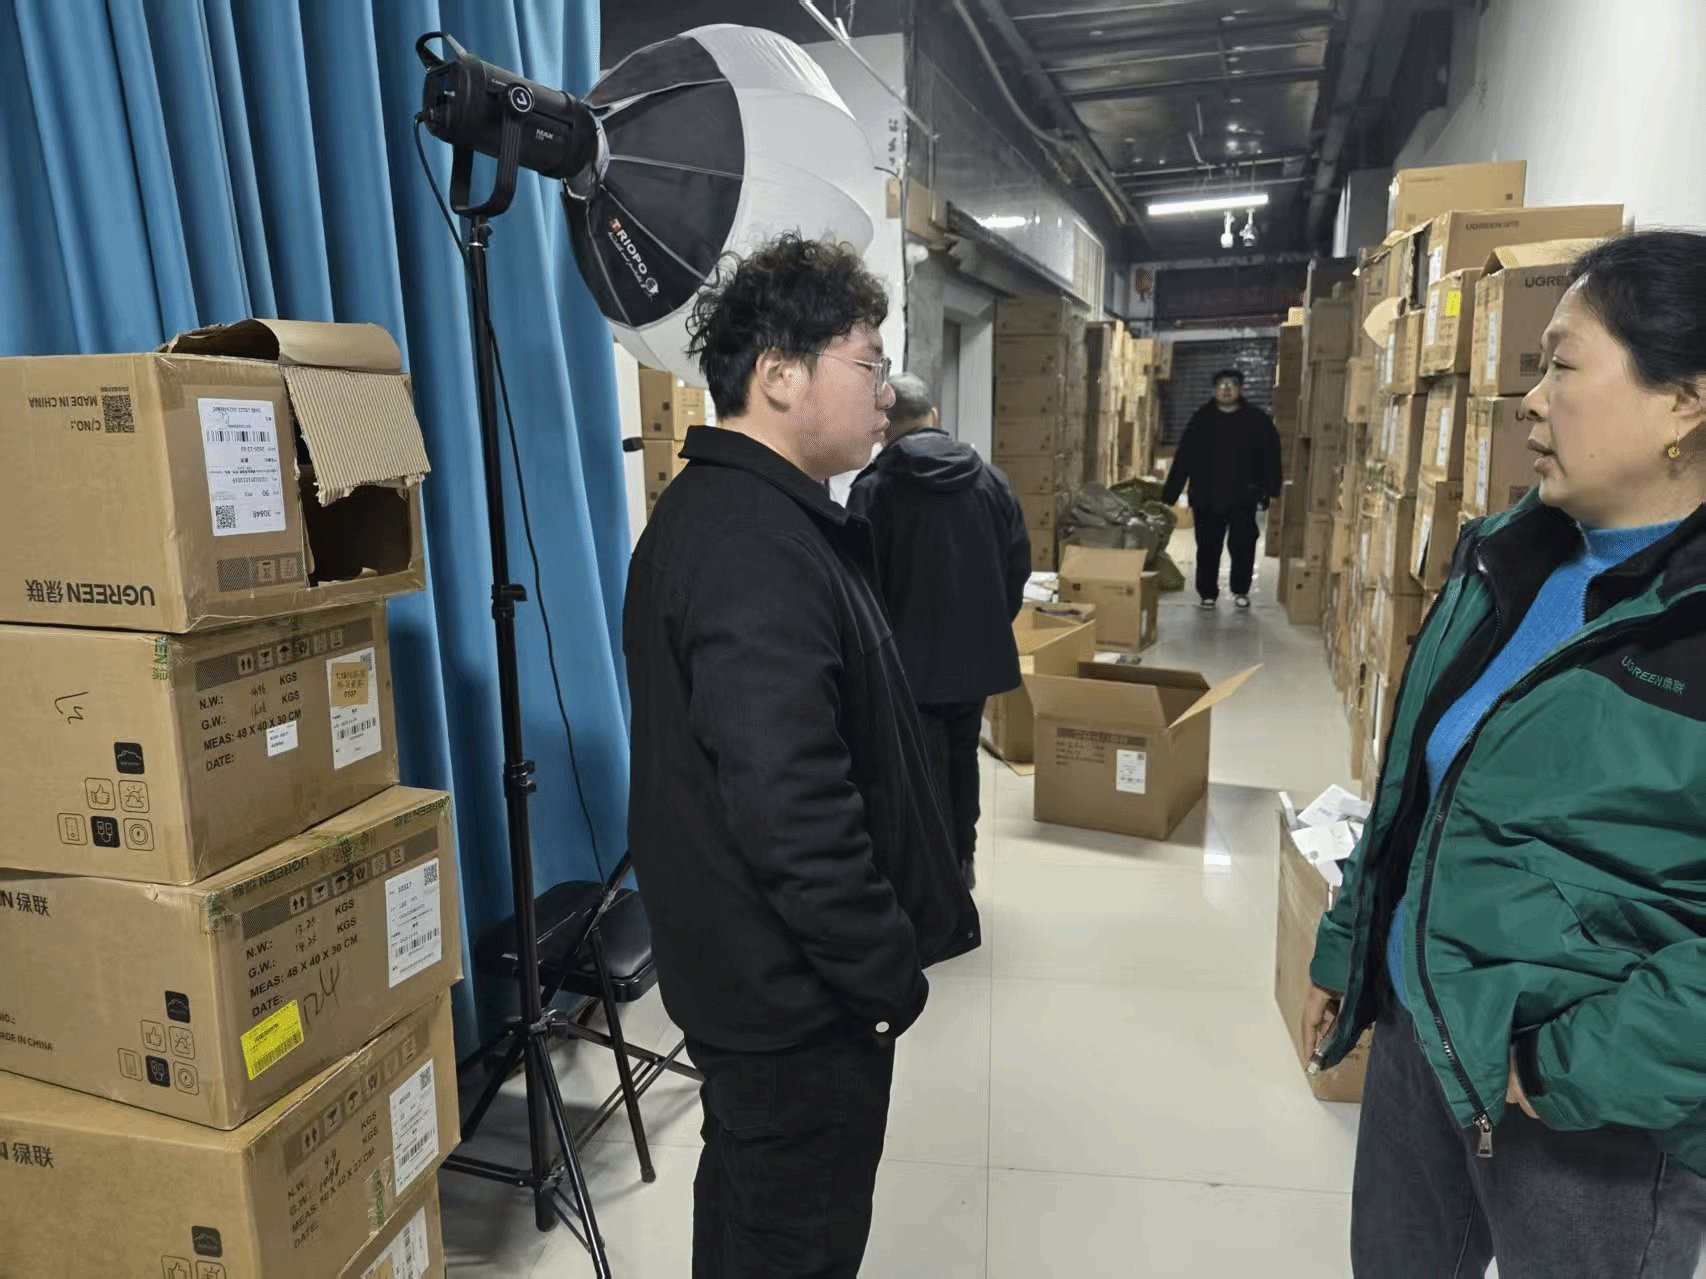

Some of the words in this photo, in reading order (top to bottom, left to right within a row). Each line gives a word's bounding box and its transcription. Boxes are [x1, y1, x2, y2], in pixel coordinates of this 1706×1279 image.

[536, 129, 554, 140] MAX
[608, 218, 648, 274] TRIOPO
[28, 396, 57, 408] CHINA
[59, 396, 69, 407] IN
[71, 395, 98, 407] MADE
[70, 418, 101, 432] C/NO.:
[25, 579, 63, 603] 绿联
[67, 582, 156, 606] UGREEN
[279, 672, 298, 686] KGS
[1621, 655, 1661, 686] UGREEN
[199, 695, 224, 710] N.W.:
[281, 690, 300, 704] KGS
[201, 715, 226, 730] G.W.:
[204, 733, 234, 751] MEAS:
[249, 725, 256, 736] X
[257, 721, 268, 732] 40
[269, 717, 276, 728] X
[277, 713, 287, 725] 30
[288, 709, 302, 721] CM
[206, 753, 234, 772] DATE:
[16, 892, 51, 919] 绿联
[335, 899, 354, 916] KGS
[337, 917, 357, 933] KGS
[246, 940, 273, 960] N.W.:
[248, 959, 276, 979] G.W.:
[249, 975, 284, 999] MEAS:
[287, 966, 298, 979] 48
[300, 961, 308, 973] X
[309, 954, 321, 967] 40
[322, 949, 330, 961] X
[331, 943, 342, 956] 30
[344, 934, 358, 949] CM
[252, 994, 284, 1018] DATE:
[18, 1034, 26, 1045] IN
[27, 1037, 53, 1050] CHINA
[361, 1110, 377, 1130] KGS
[362, 1126, 378, 1145] KGS
[13, 1142, 54, 1168] 绿联
